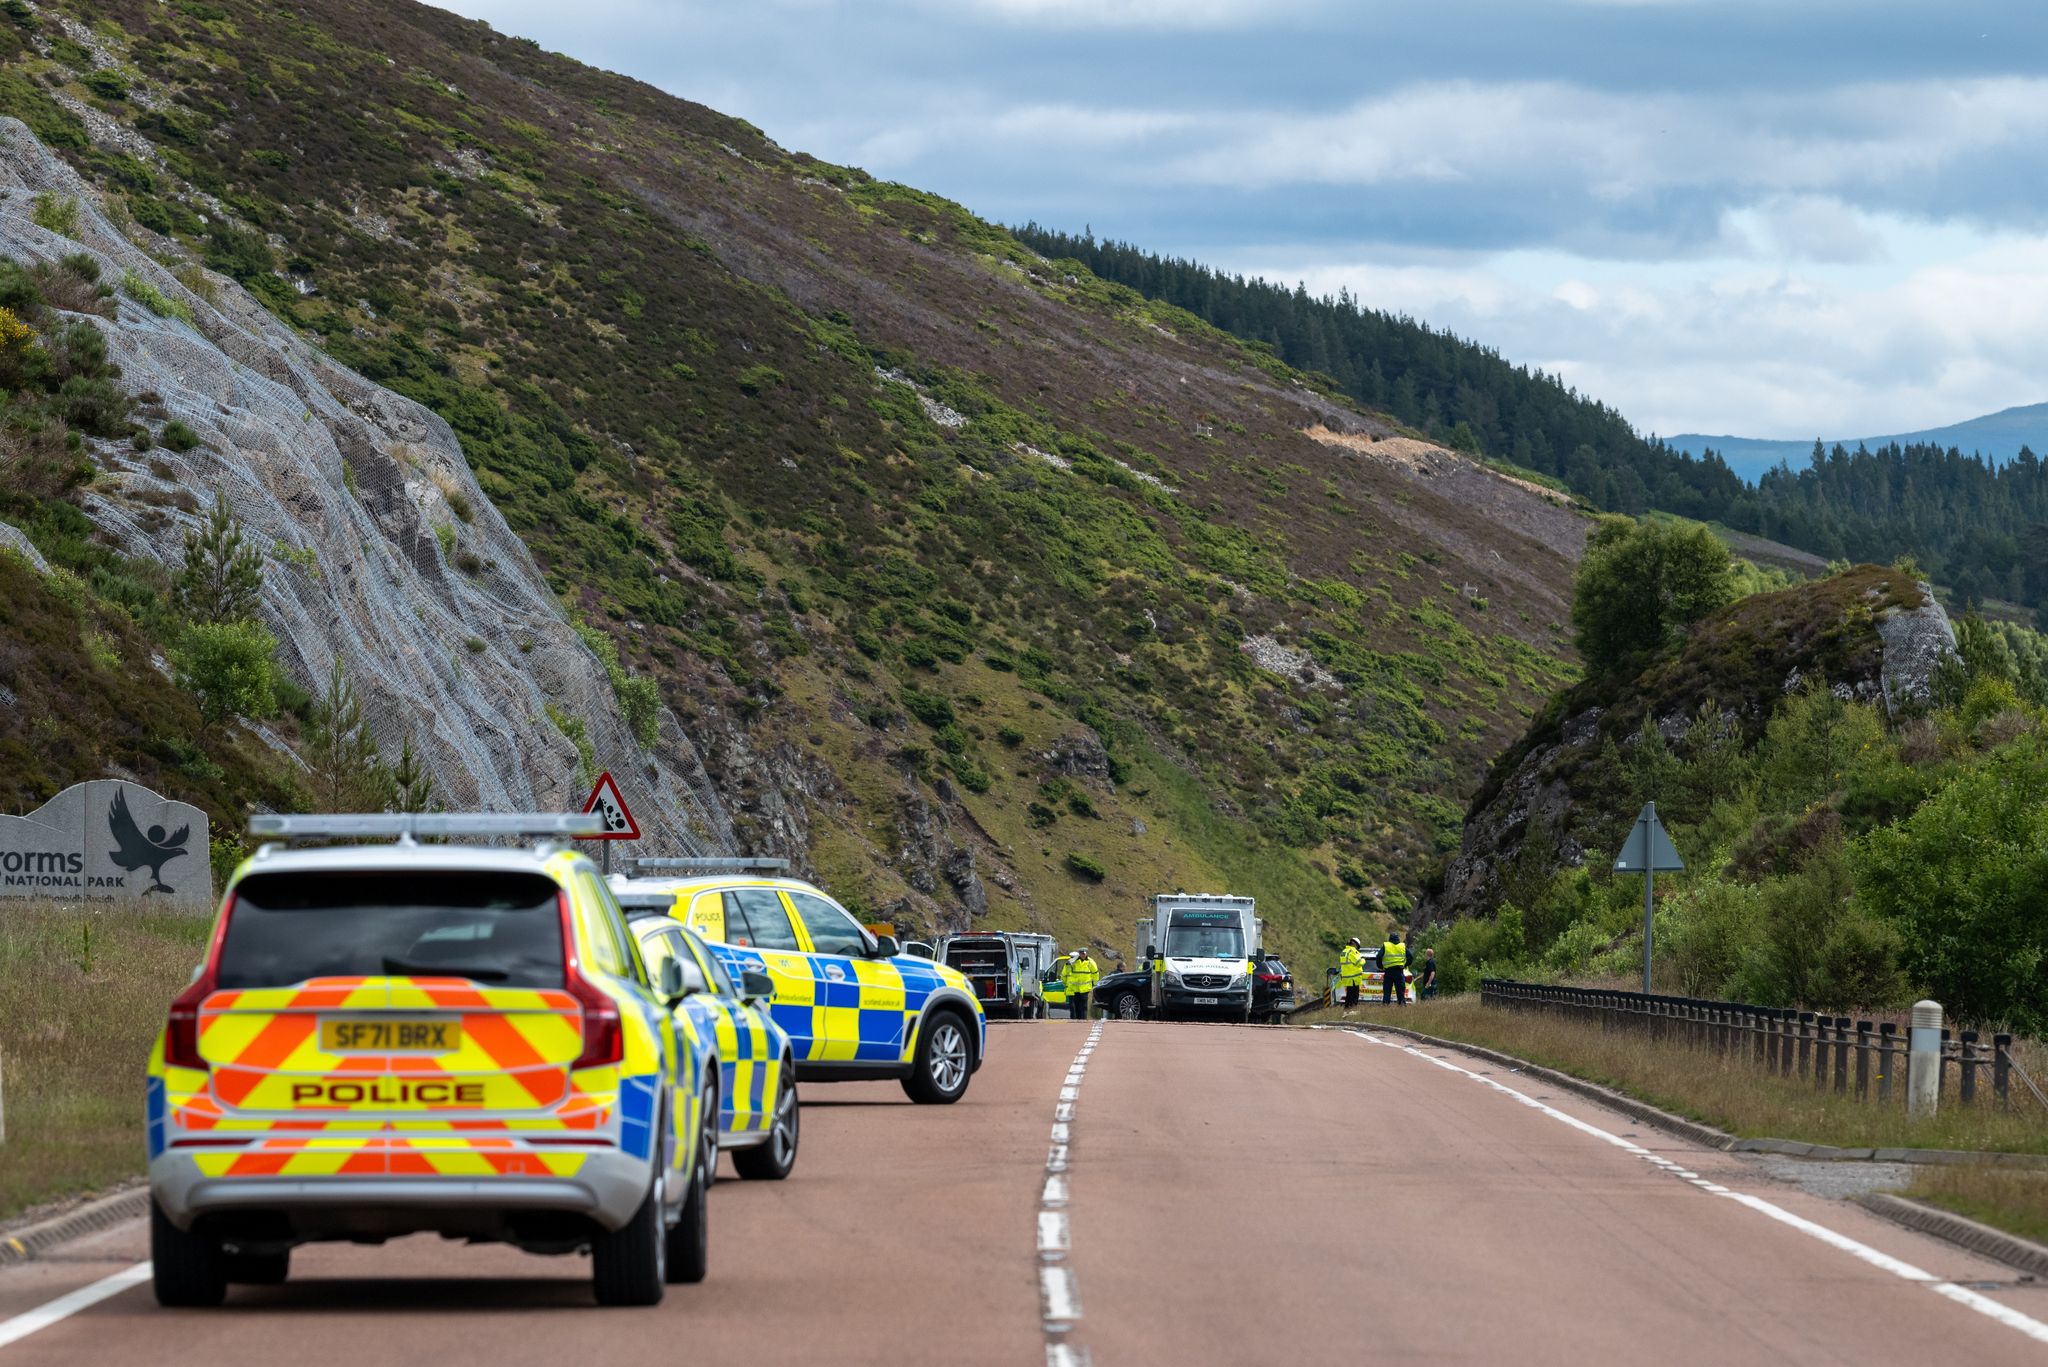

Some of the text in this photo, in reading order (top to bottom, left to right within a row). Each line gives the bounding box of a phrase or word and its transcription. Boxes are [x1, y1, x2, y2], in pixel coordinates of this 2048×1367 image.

[5, 875, 125, 888] NATIONAL PARK
[335, 1023, 447, 1047] SF71 BRX
[292, 1083, 485, 1104] POLICE
